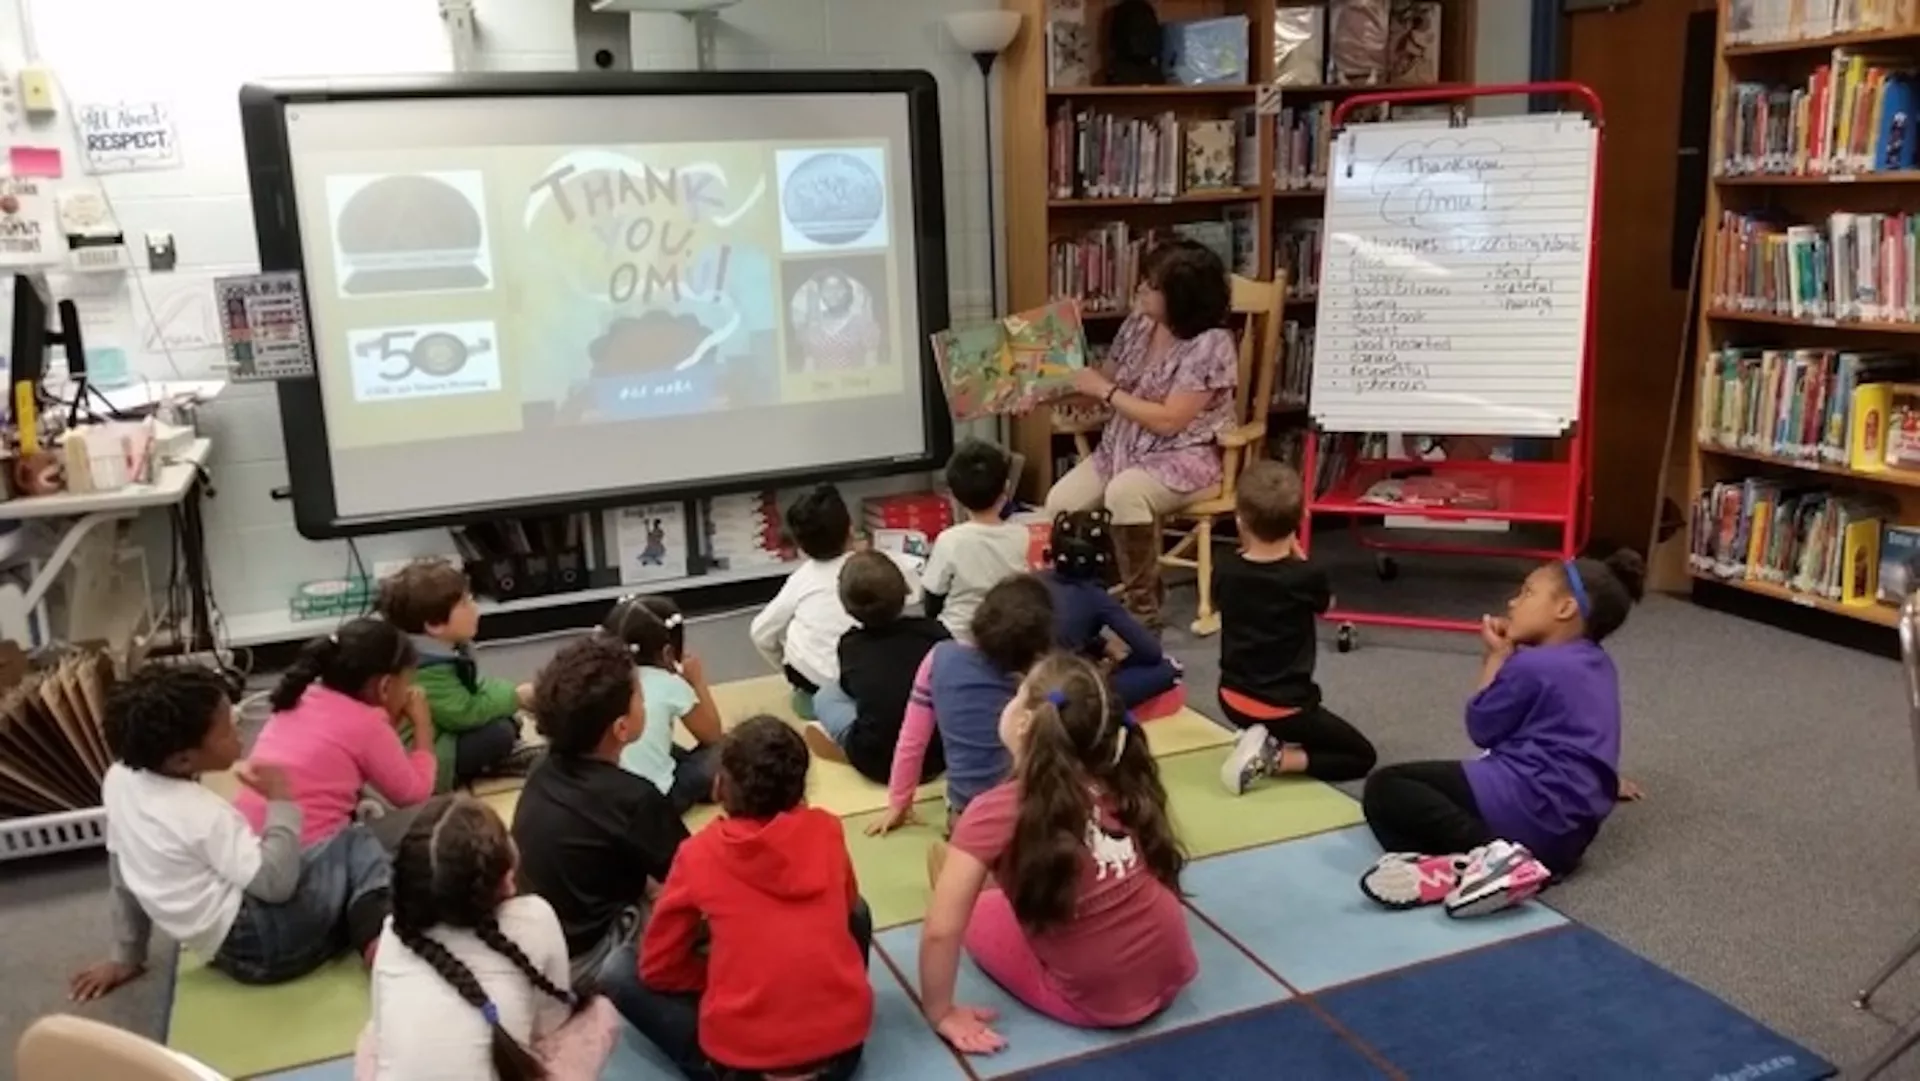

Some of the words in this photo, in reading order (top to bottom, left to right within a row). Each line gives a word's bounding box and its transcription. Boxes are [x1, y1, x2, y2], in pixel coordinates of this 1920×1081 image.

[87, 129, 167, 152] RESPECT
[1401, 155, 1463, 174] Thank
[529, 162, 727, 225] THANK
[608, 244, 732, 304] OMU!
